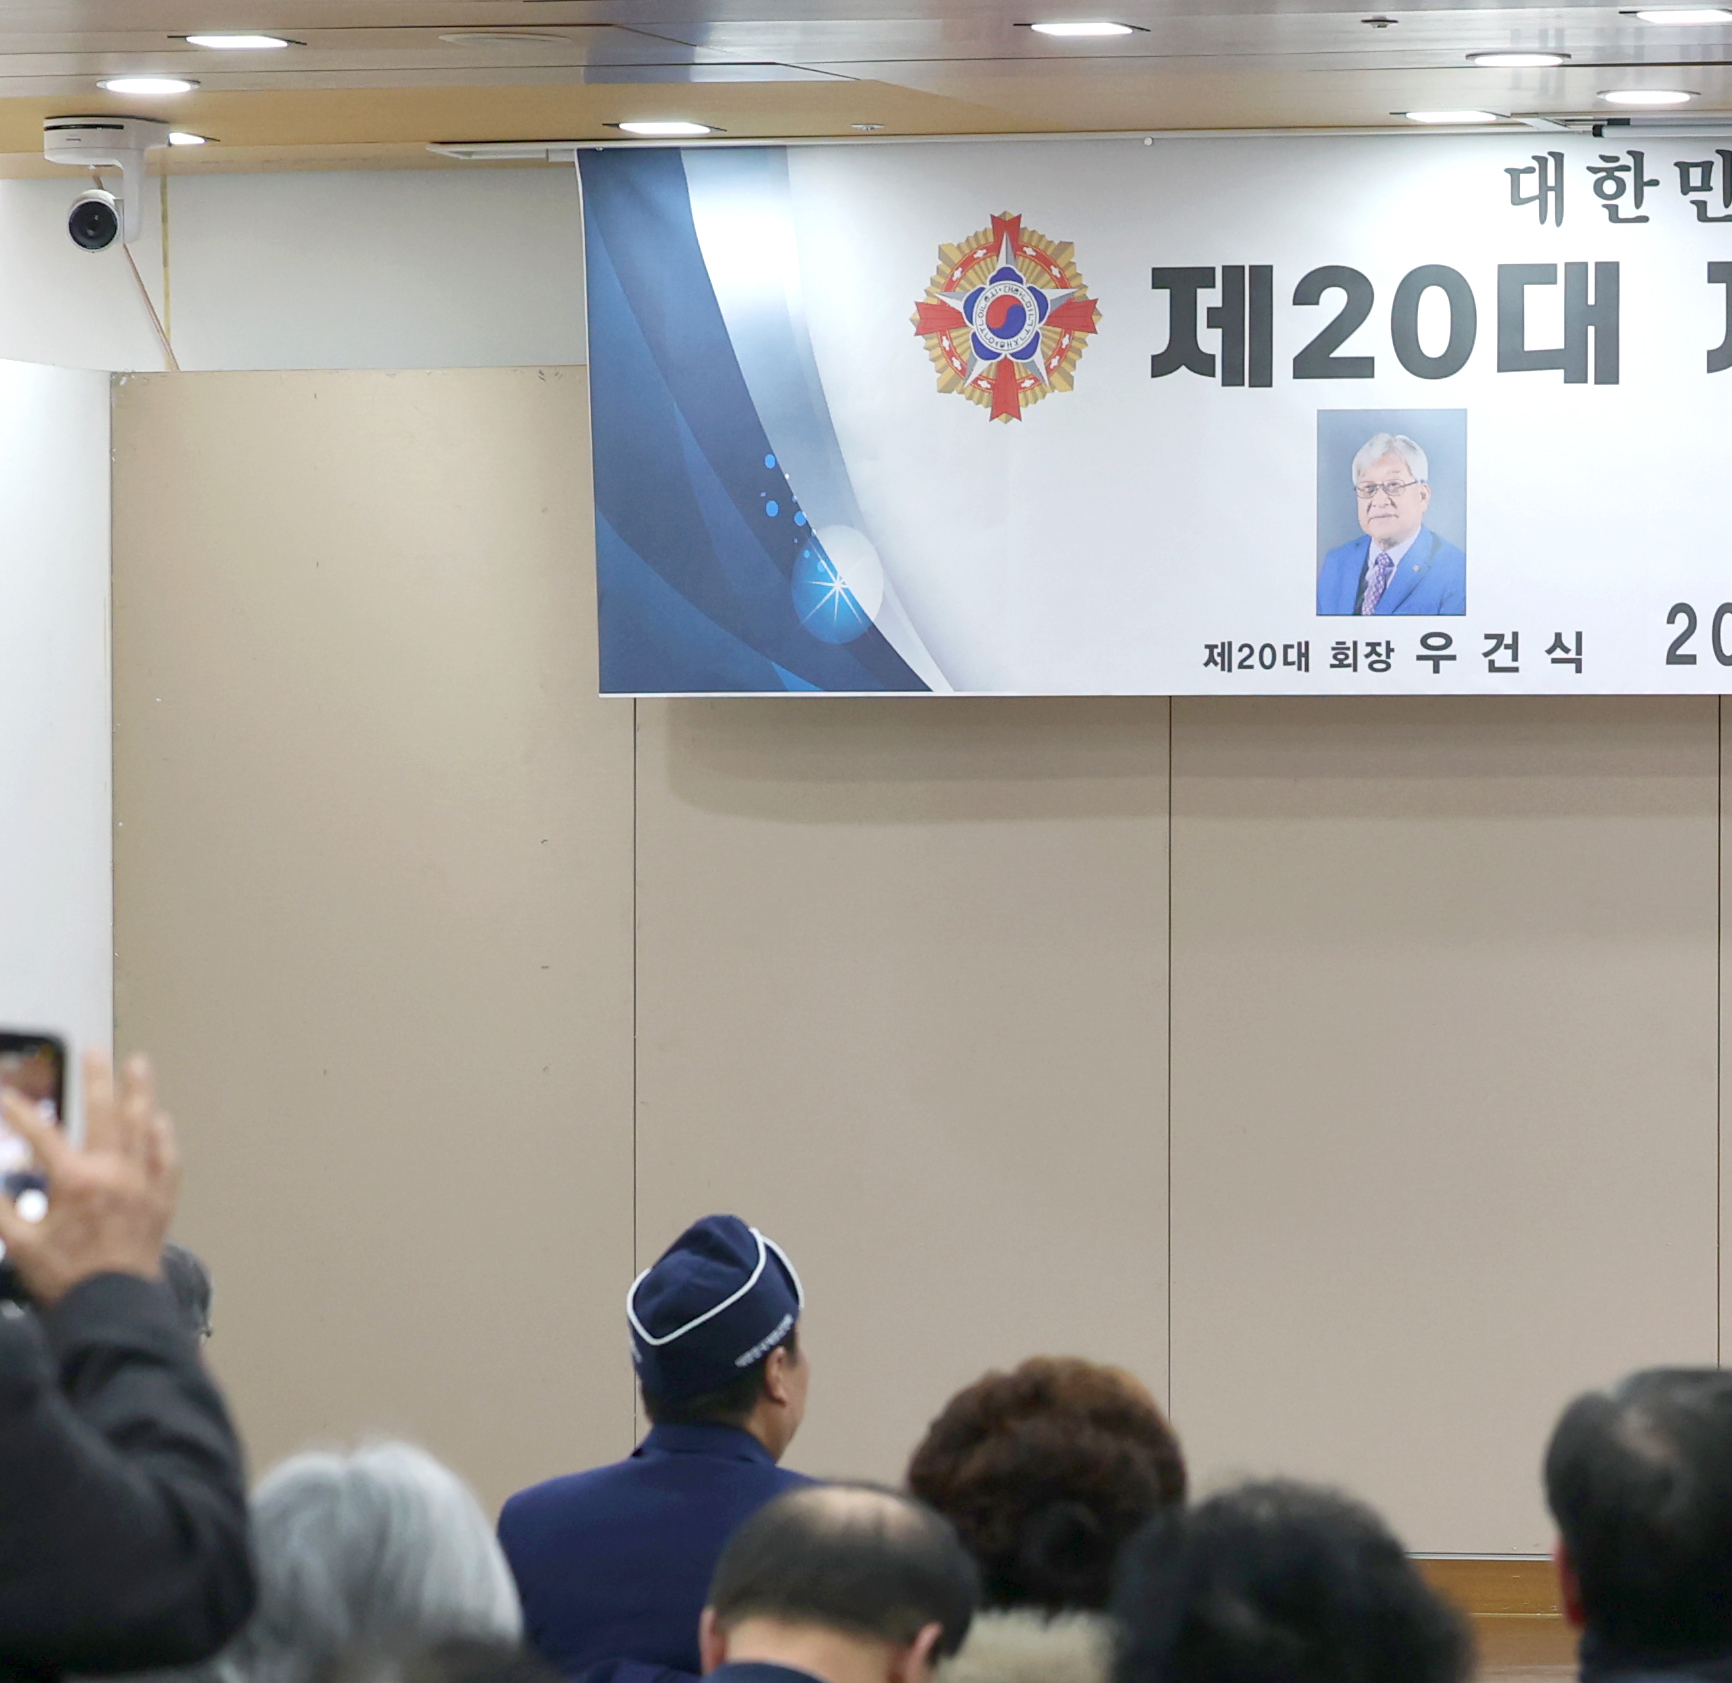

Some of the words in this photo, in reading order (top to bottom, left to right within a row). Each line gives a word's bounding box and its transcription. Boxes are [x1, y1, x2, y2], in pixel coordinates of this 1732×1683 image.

[1150, 261, 1621, 389] 제20대
[1202, 640, 1310, 674] 제20대
[1329, 639, 1396, 673] 회장
